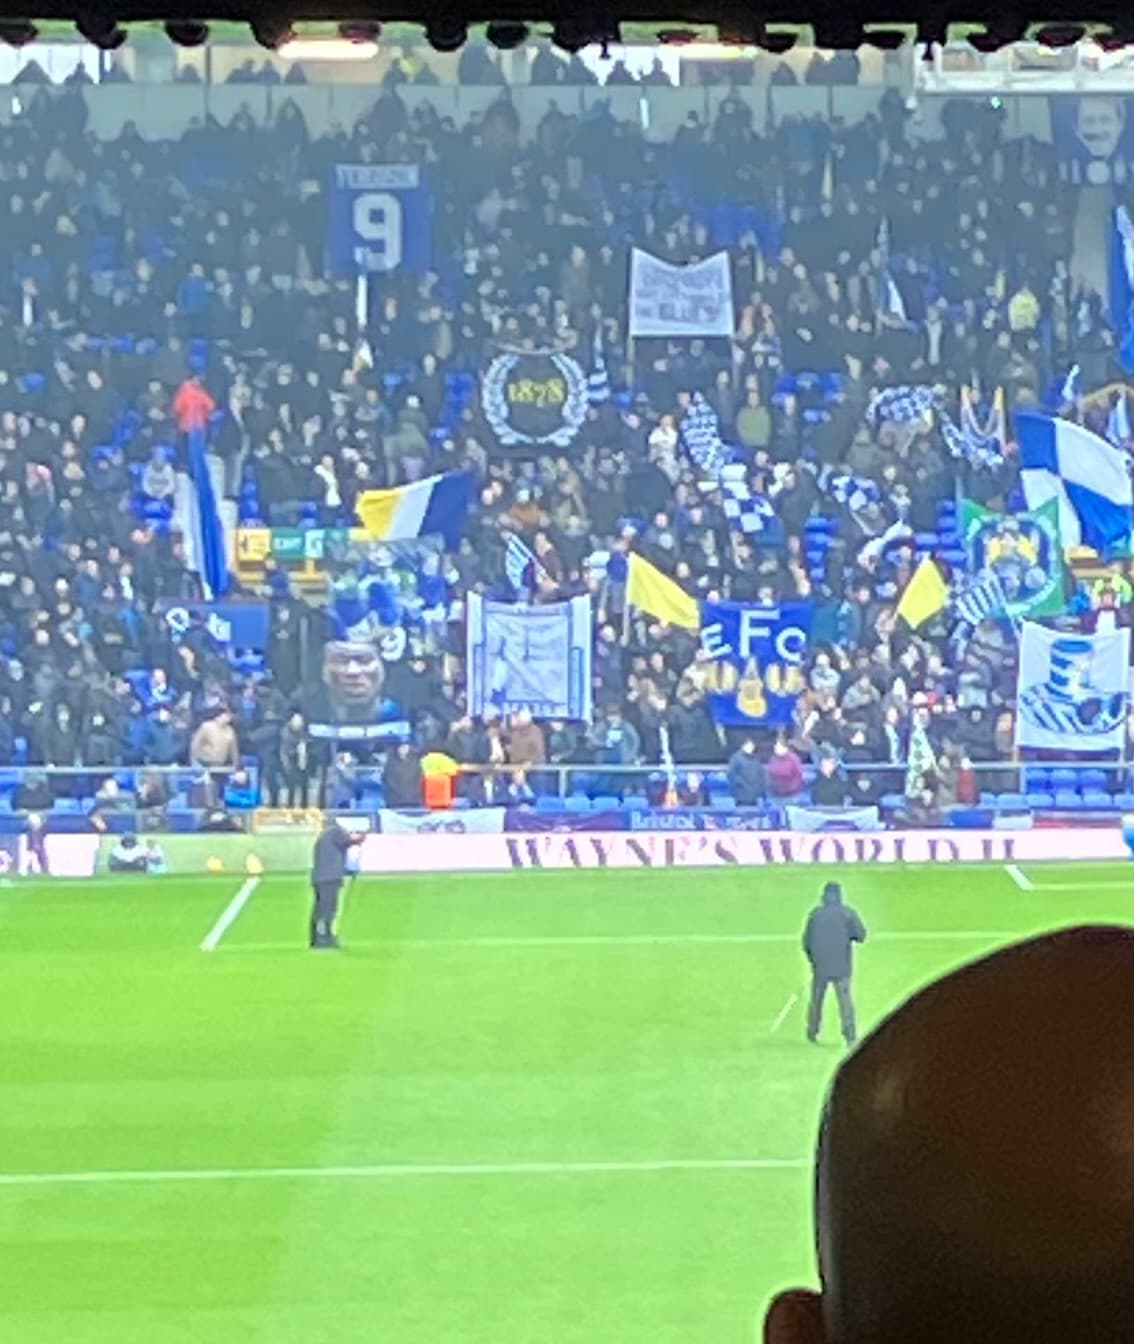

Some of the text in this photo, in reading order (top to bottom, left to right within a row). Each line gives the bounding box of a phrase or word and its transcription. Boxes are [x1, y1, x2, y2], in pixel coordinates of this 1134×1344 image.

[354, 194, 402, 271] 9
[508, 378, 565, 407] 1878
[701, 609, 806, 662] EFC
[759, 838, 960, 864] WORLD
